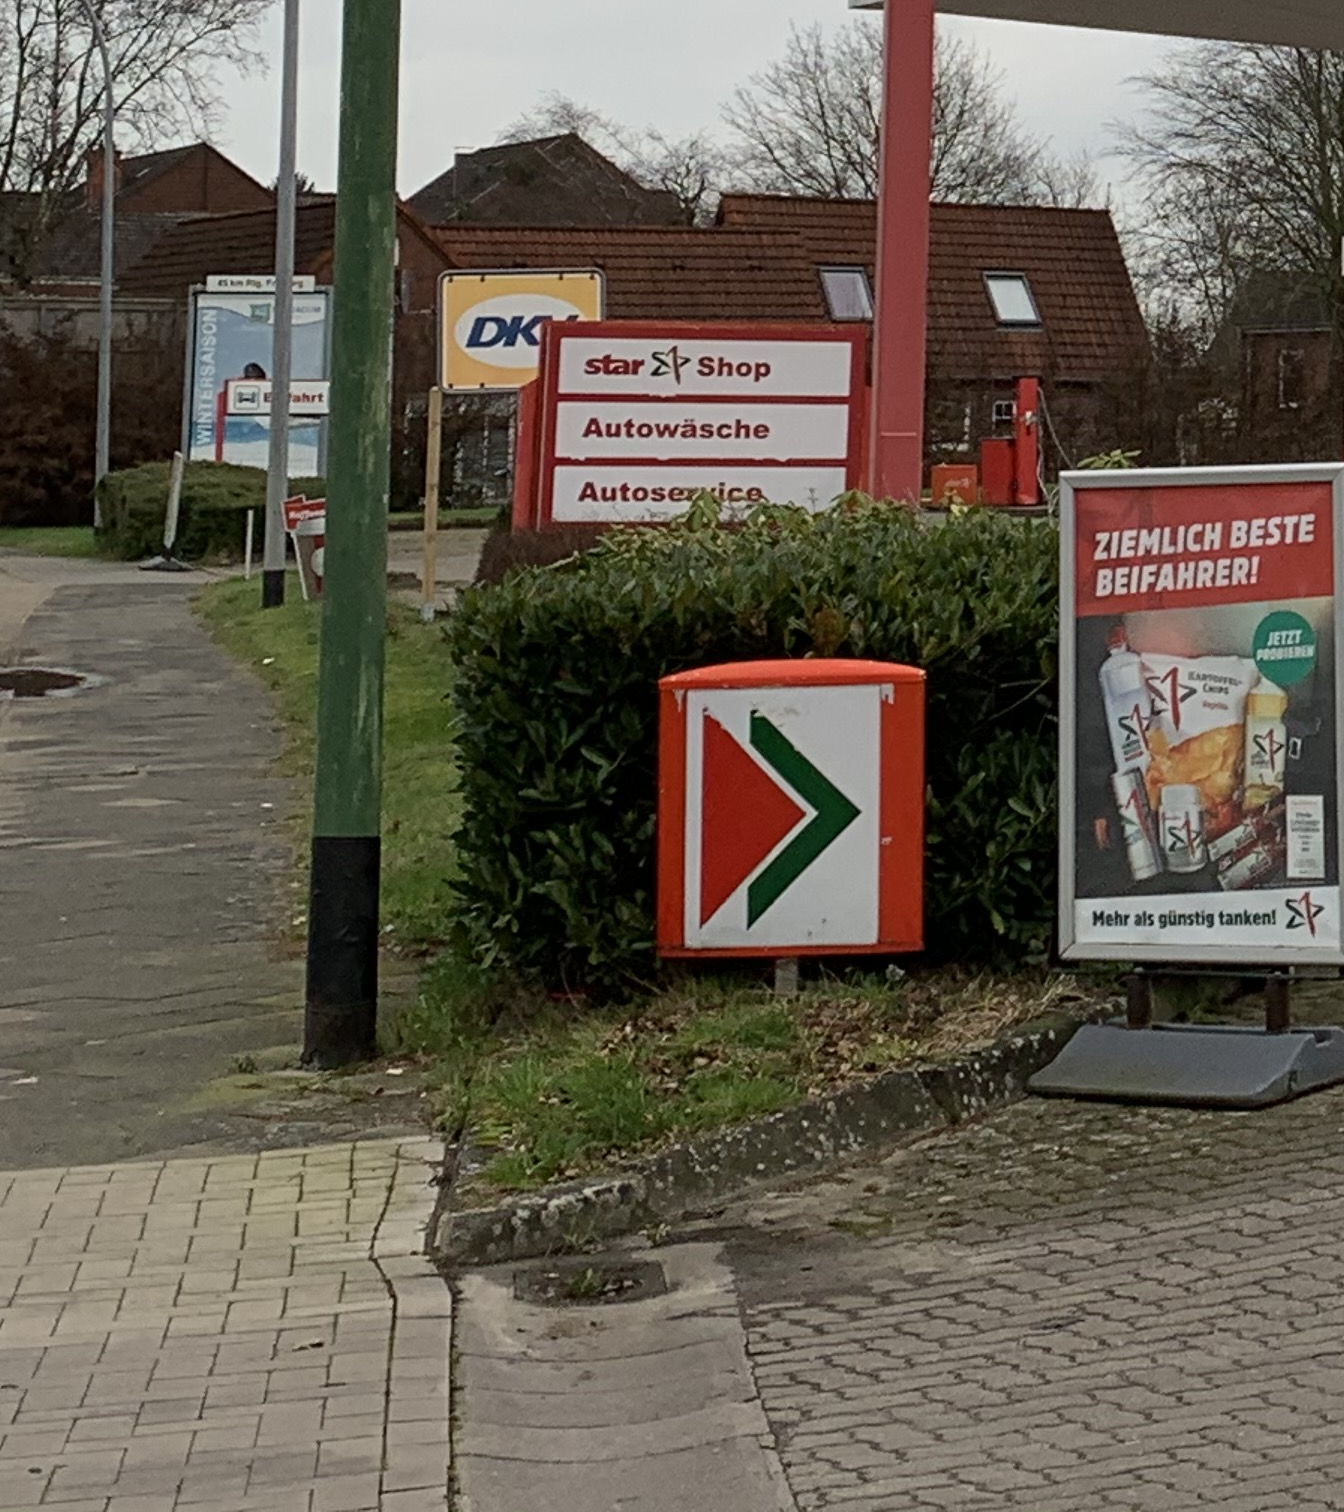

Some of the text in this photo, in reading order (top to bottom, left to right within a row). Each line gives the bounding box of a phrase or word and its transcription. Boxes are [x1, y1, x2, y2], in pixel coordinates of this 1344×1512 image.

[466, 315, 579, 348] DK
[196, 308, 217, 446] WINTERSAISON
[584, 354, 771, 383] star Shop
[582, 417, 770, 440] Autowäsche
[1094, 513, 1316, 561] ZIEMLICH BESTE
[1094, 555, 1261, 598] BEIFAHRER!
[1256, 644, 1315, 661] PROBIEREN
[1267, 629, 1303, 647] JETZT
[1092, 909, 1277, 930] Mehr als günstig tanken!
